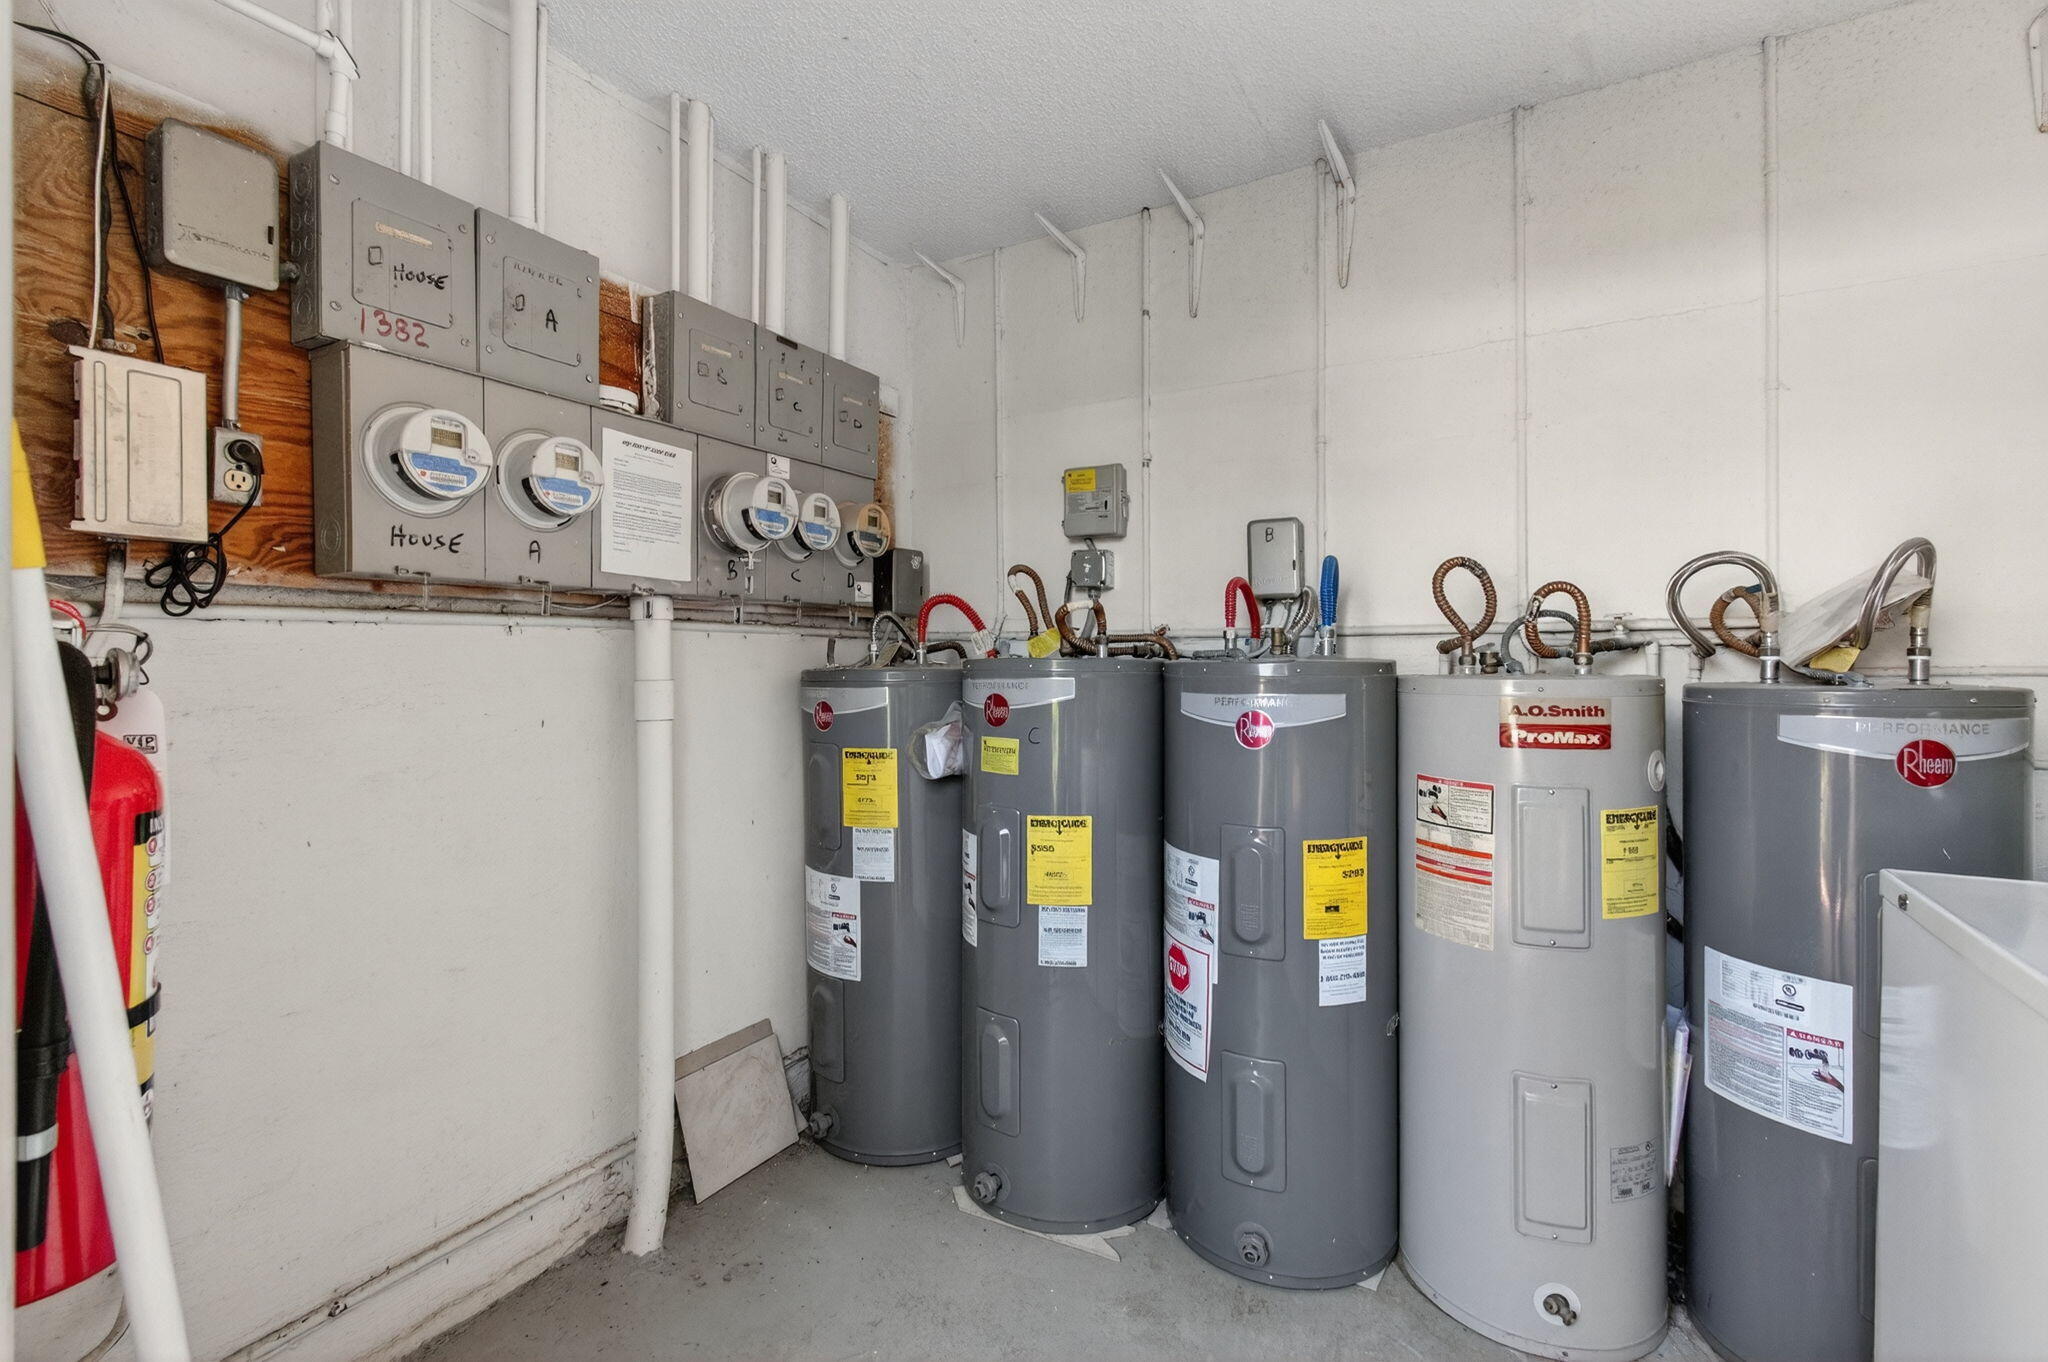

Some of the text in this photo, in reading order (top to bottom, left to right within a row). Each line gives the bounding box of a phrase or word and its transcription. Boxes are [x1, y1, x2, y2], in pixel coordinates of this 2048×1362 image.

[393, 263, 449, 290] HOUSE
[360, 307, 430, 349] 1382
[545, 308, 559, 333] A
[390, 524, 465, 554] HOUSE
[1265, 526, 1274, 543] B
[528, 540, 541, 565] A
[726, 559, 738, 581] B
[791, 568, 802, 583] C
[847, 572, 855, 589] D
[1027, 726, 1040, 745] C
[1511, 728, 1601, 745] ProMax
[1902, 739, 1954, 780] Rheem
